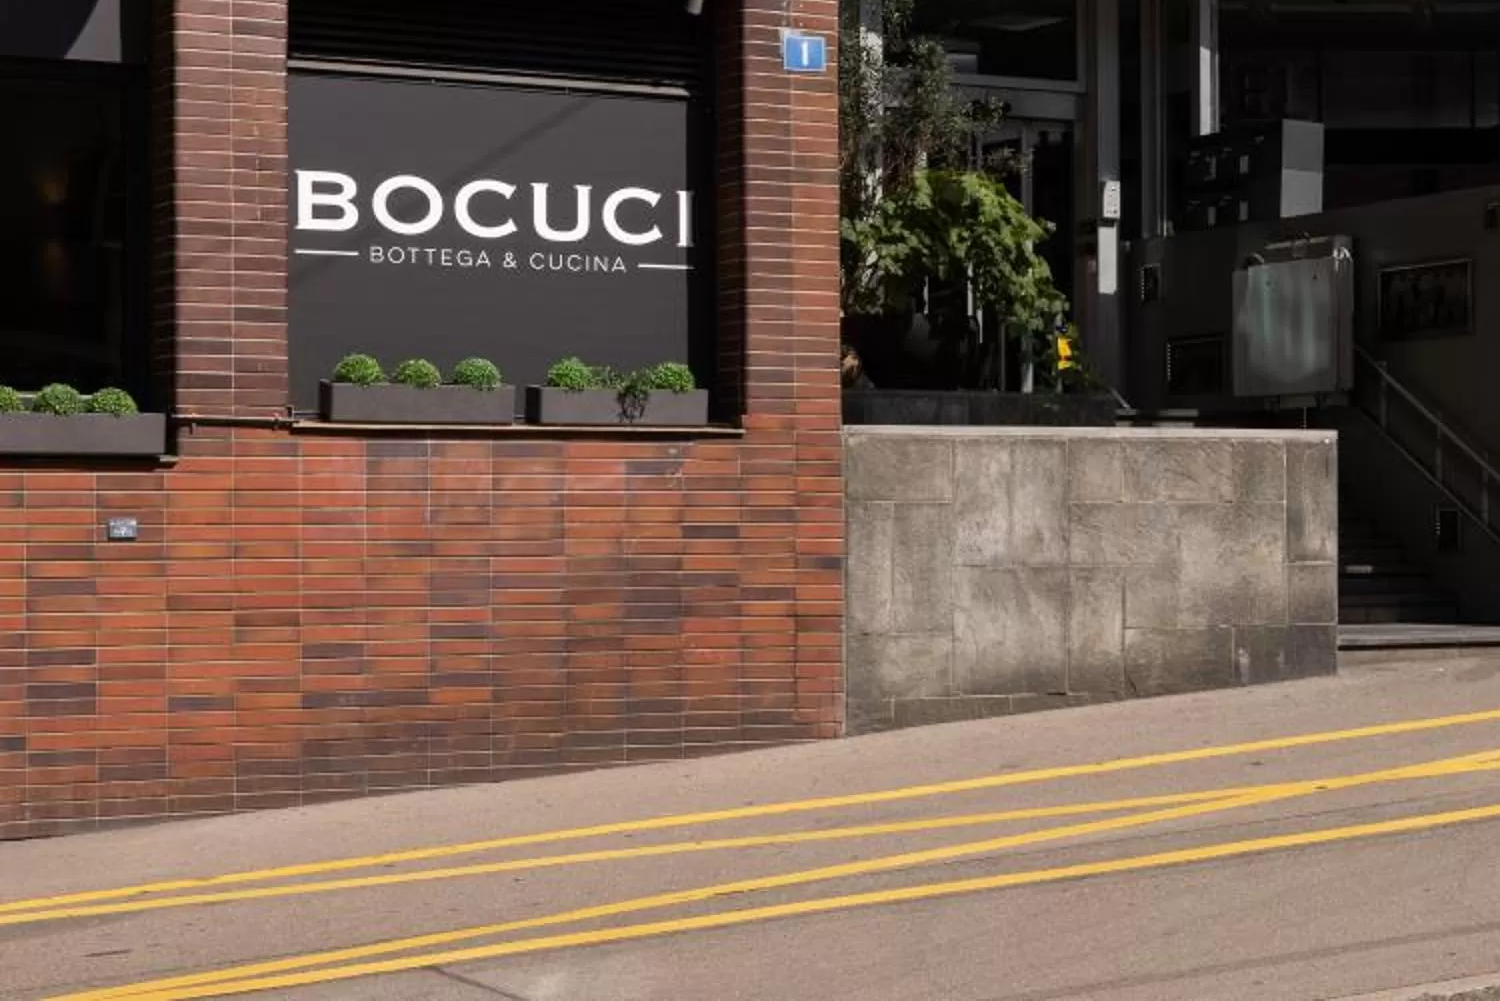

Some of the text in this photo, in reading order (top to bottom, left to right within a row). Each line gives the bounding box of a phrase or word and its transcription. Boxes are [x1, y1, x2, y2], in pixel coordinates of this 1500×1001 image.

[802, 40, 809, 66] 1
[294, 169, 697, 248] BOCUCI
[369, 246, 627, 273] BOTTEGA & CUCINA
